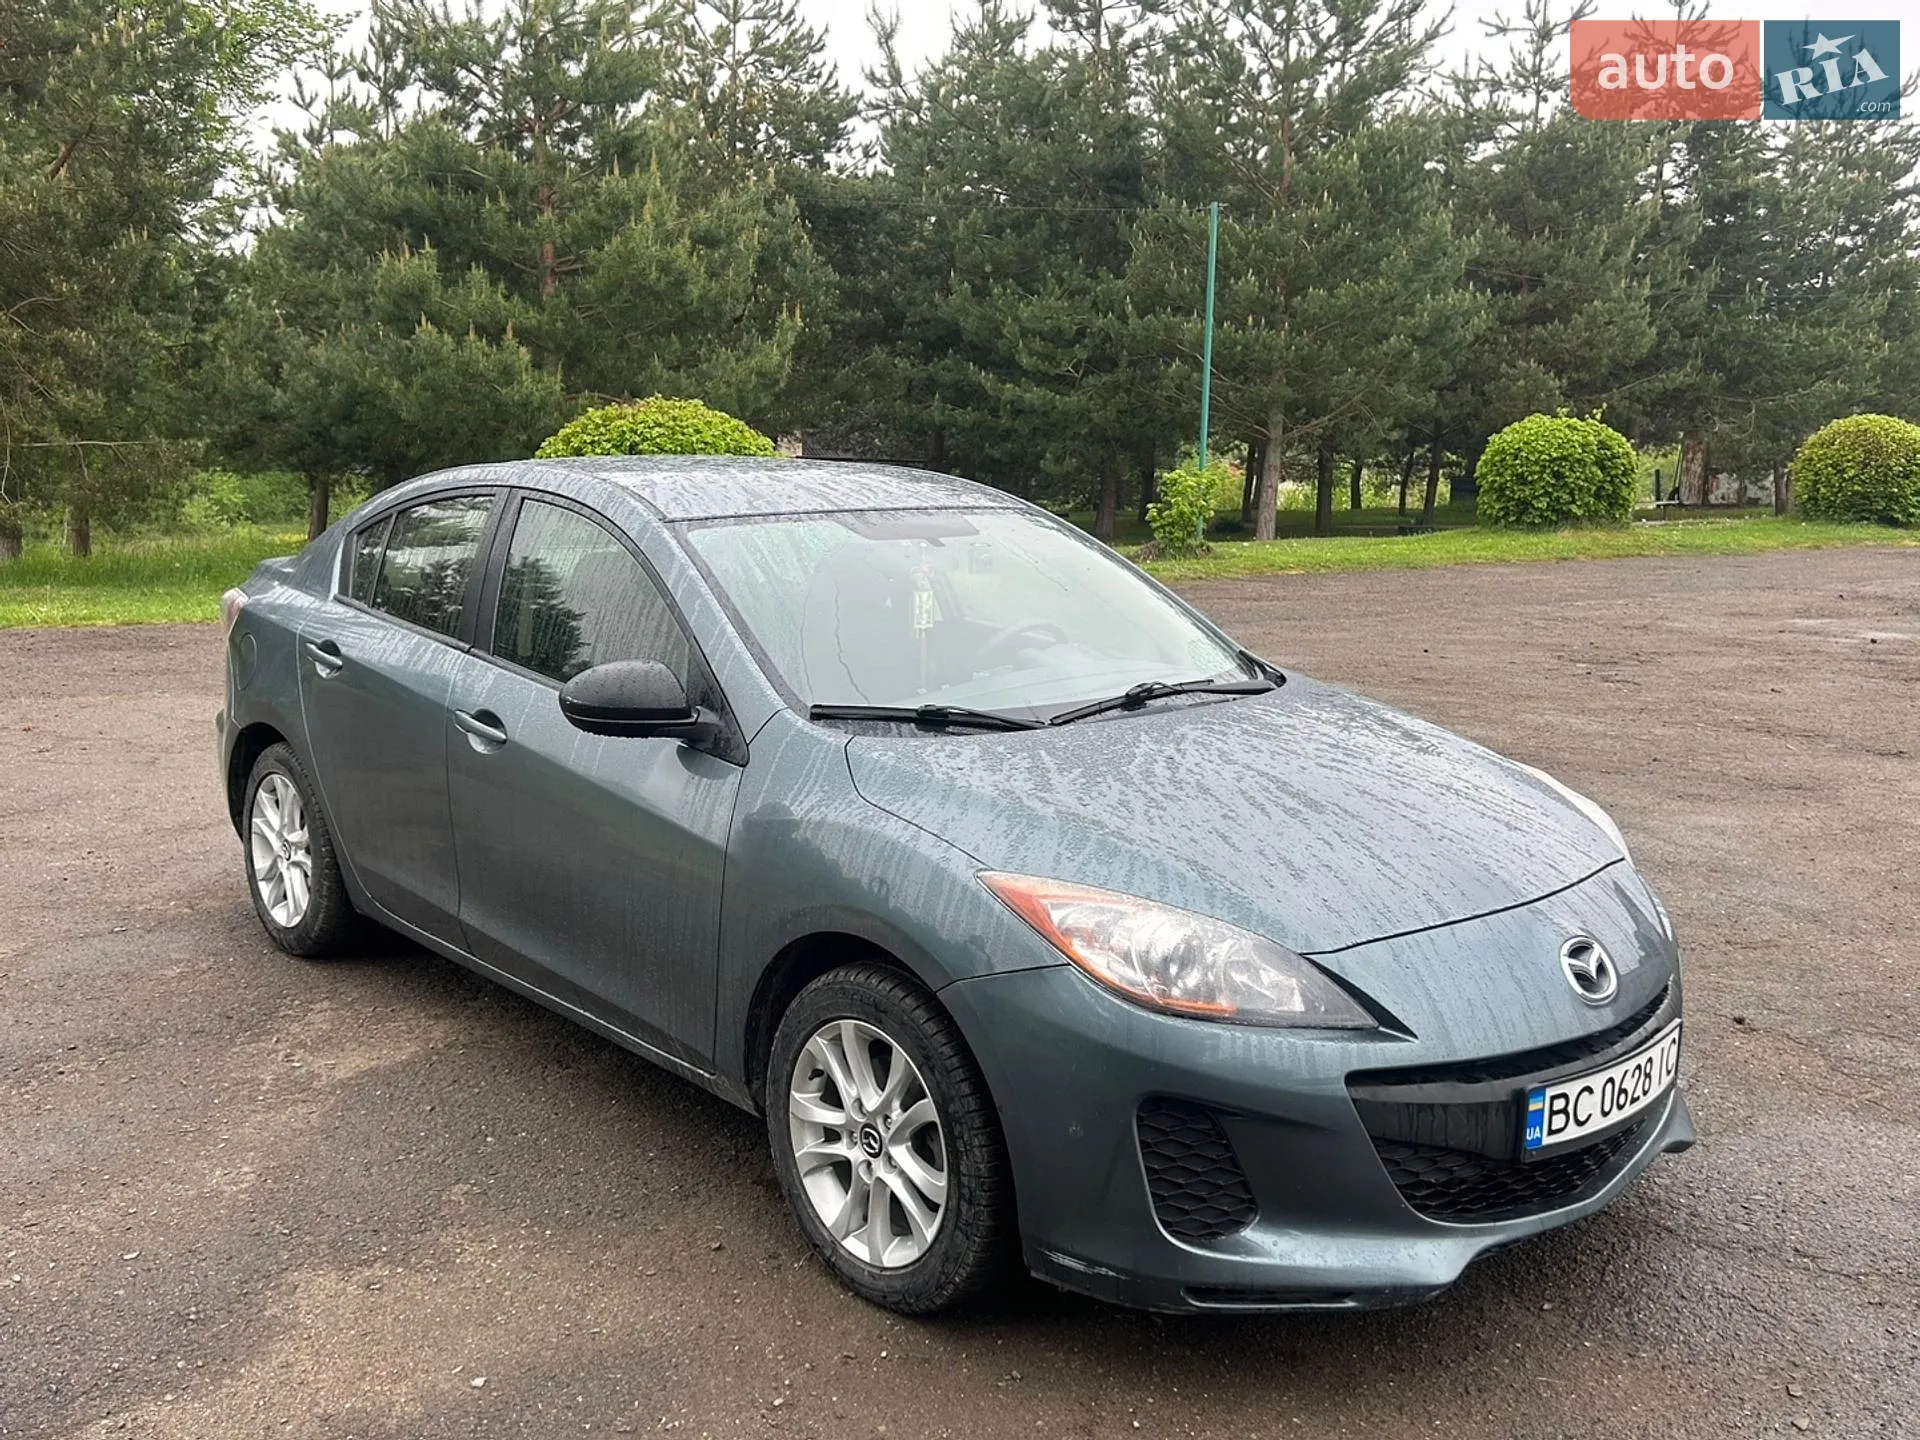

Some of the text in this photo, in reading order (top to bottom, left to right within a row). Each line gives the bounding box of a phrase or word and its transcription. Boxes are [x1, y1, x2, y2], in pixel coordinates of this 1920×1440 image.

[1547, 1037, 1676, 1137] BC 0628 IC
[1526, 1127, 1541, 1140] UA
